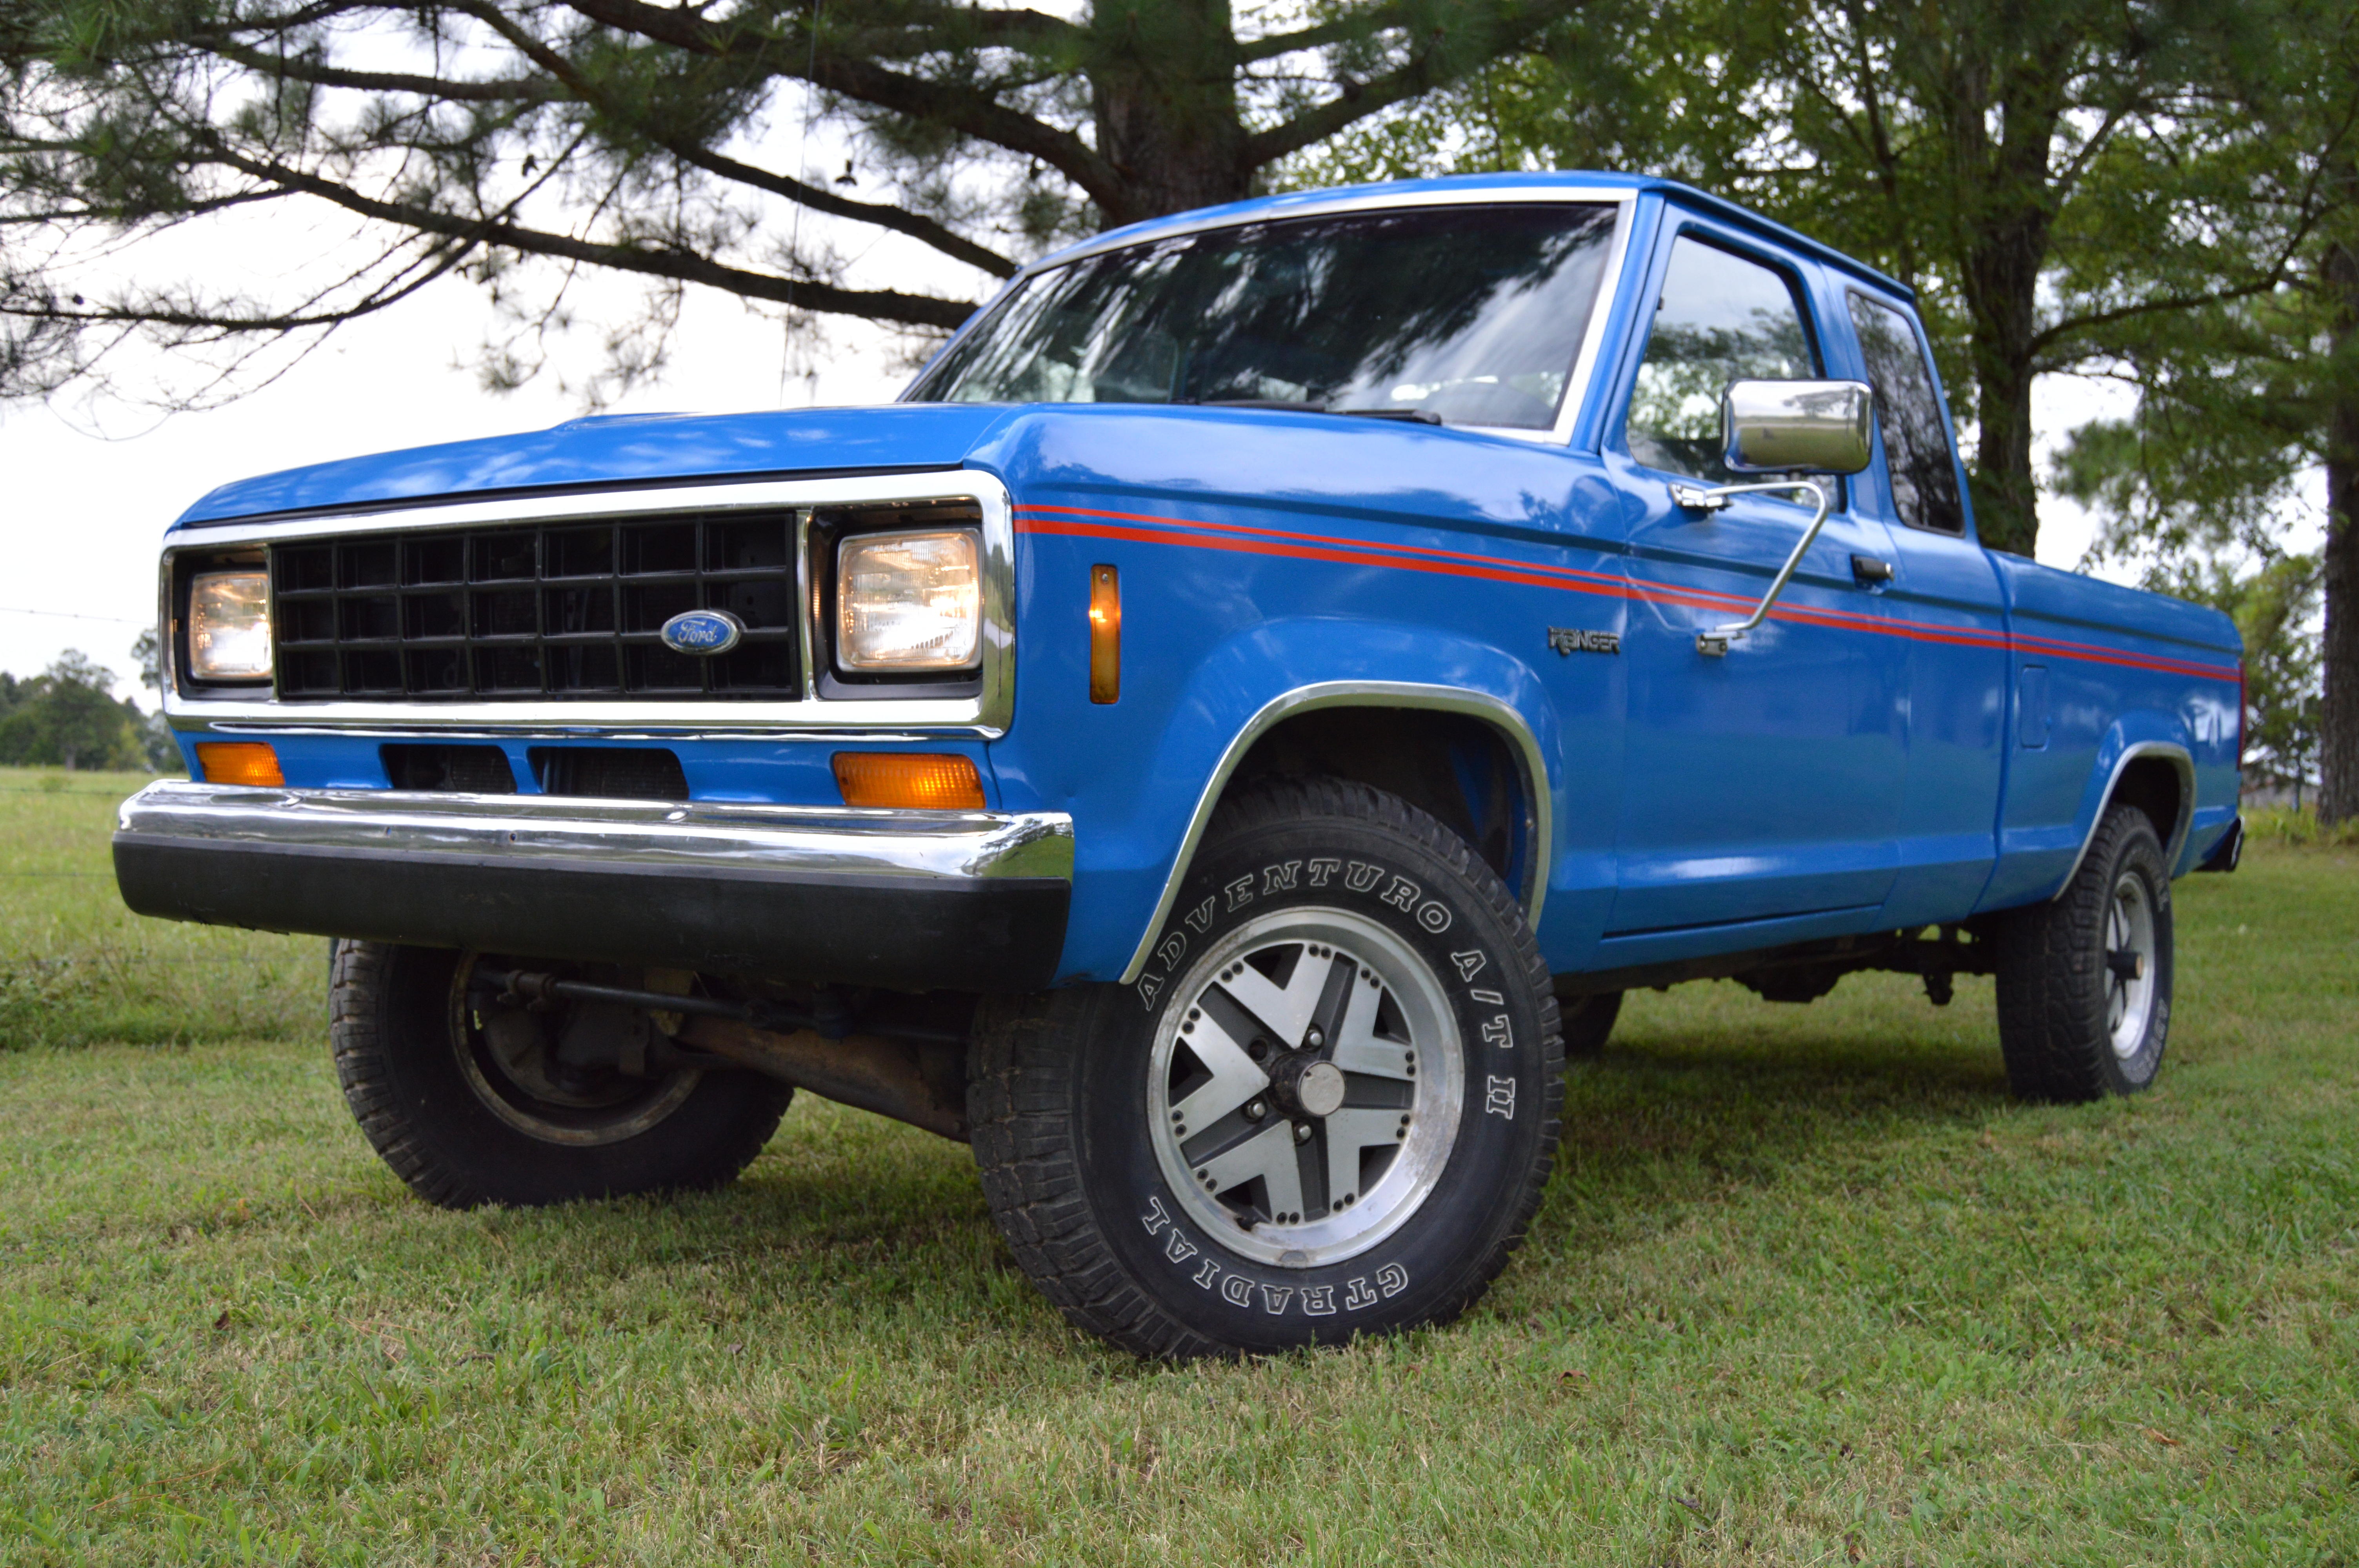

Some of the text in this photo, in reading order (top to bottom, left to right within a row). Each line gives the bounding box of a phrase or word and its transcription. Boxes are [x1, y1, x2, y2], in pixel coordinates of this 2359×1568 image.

[678, 620, 718, 643] Ford
[1548, 626, 1620, 656] RANGER
[1137, 858, 1515, 1120] ADVENTURO A/T II
